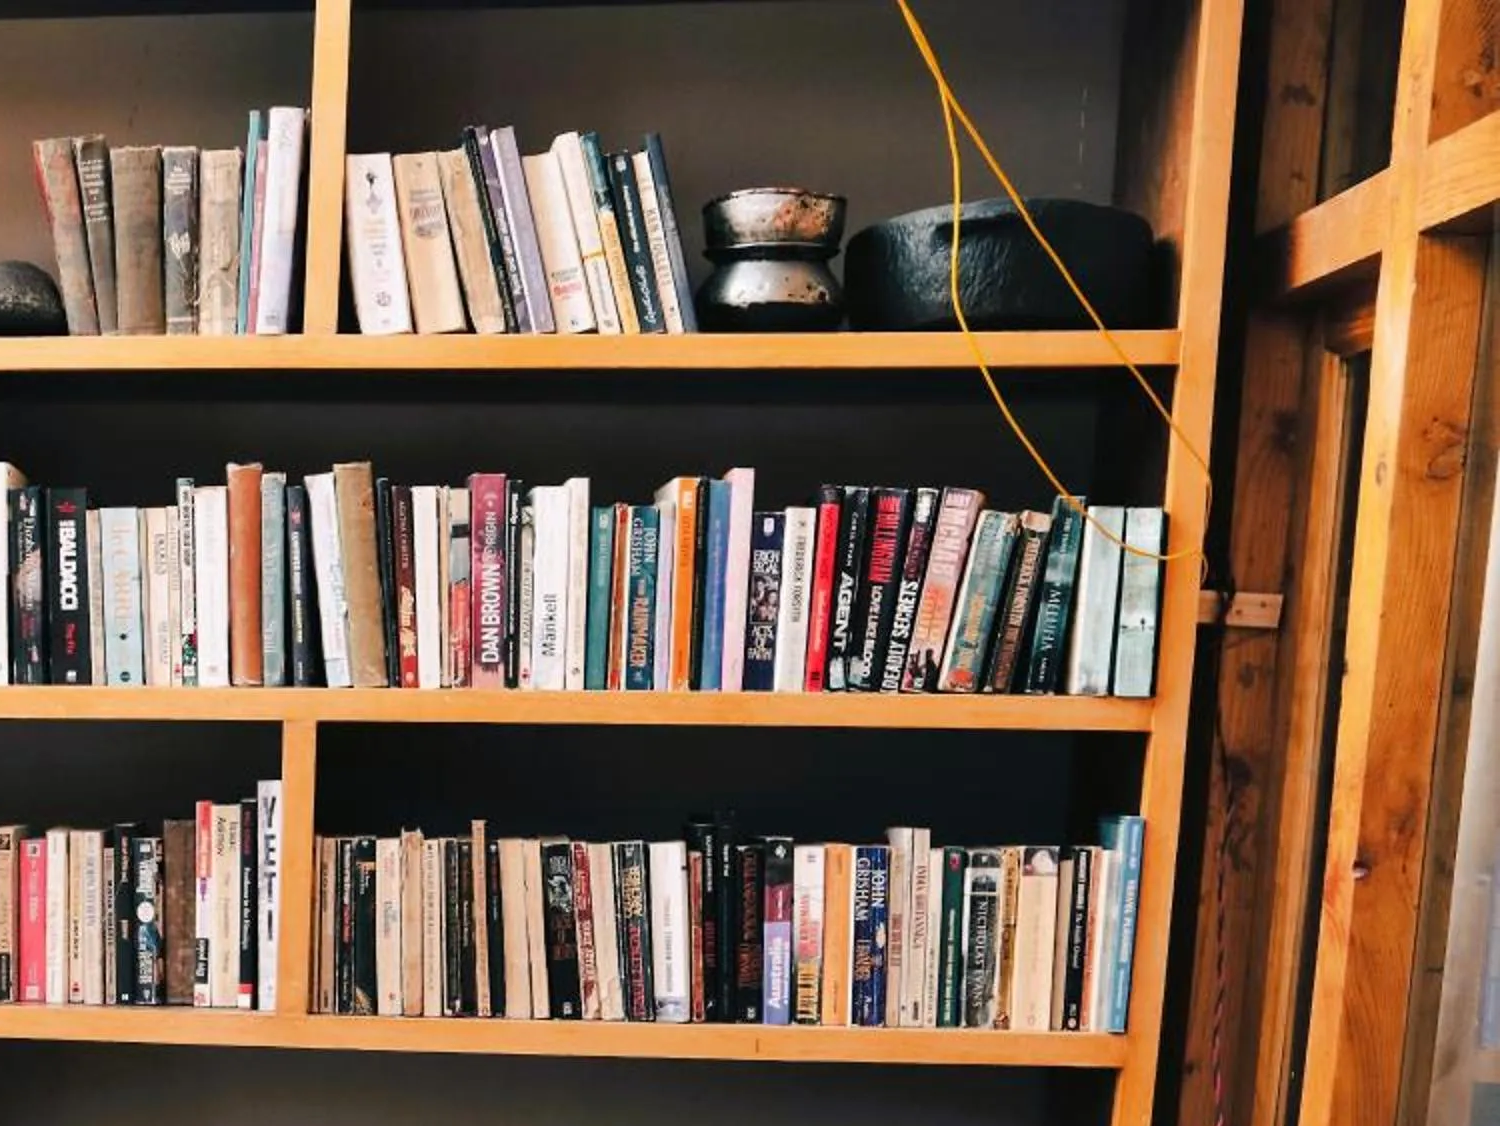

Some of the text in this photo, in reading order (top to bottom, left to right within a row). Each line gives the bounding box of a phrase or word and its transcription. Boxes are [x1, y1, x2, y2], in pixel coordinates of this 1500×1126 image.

[59, 528, 78, 611] BALDACCI
[867, 512, 898, 584] BILLINGHAM
[481, 563, 500, 627] BROWN
[542, 593, 558, 658] Mankell
[629, 517, 657, 669] JOHN GRISHAM RAINMAKER
[832, 571, 854, 652] AGENT
[481, 627, 500, 664] DAN
[860, 639, 875, 678] BLOOD
[881, 580, 919, 690] DEADLY SECRETS
[855, 857, 885, 922] JOHN GRISHAM
[971, 900, 989, 1009] NICHOLAS EVANS
